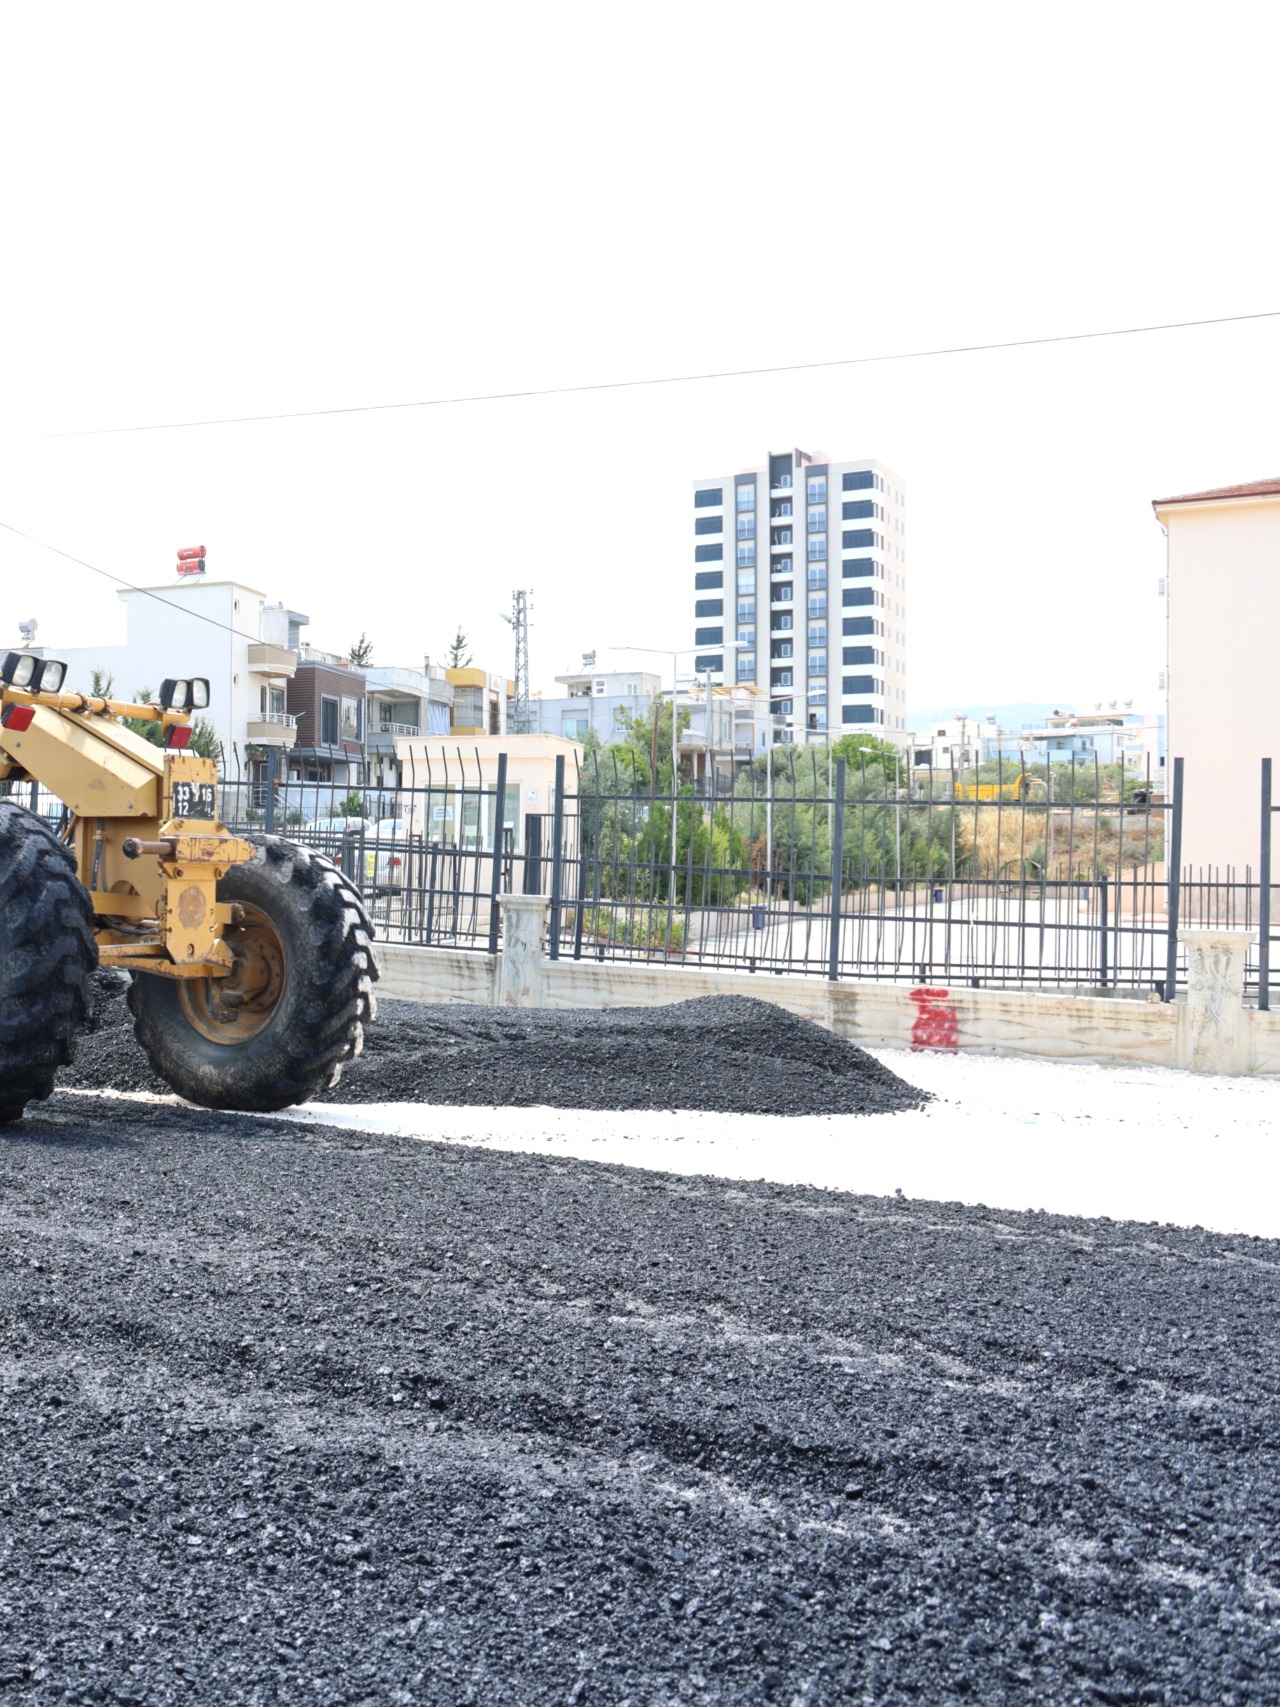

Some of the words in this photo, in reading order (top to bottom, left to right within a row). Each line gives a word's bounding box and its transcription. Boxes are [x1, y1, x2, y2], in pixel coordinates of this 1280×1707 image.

[177, 785, 190, 800] 33
[202, 787, 213, 802] 16
[178, 801, 189, 816] 12
